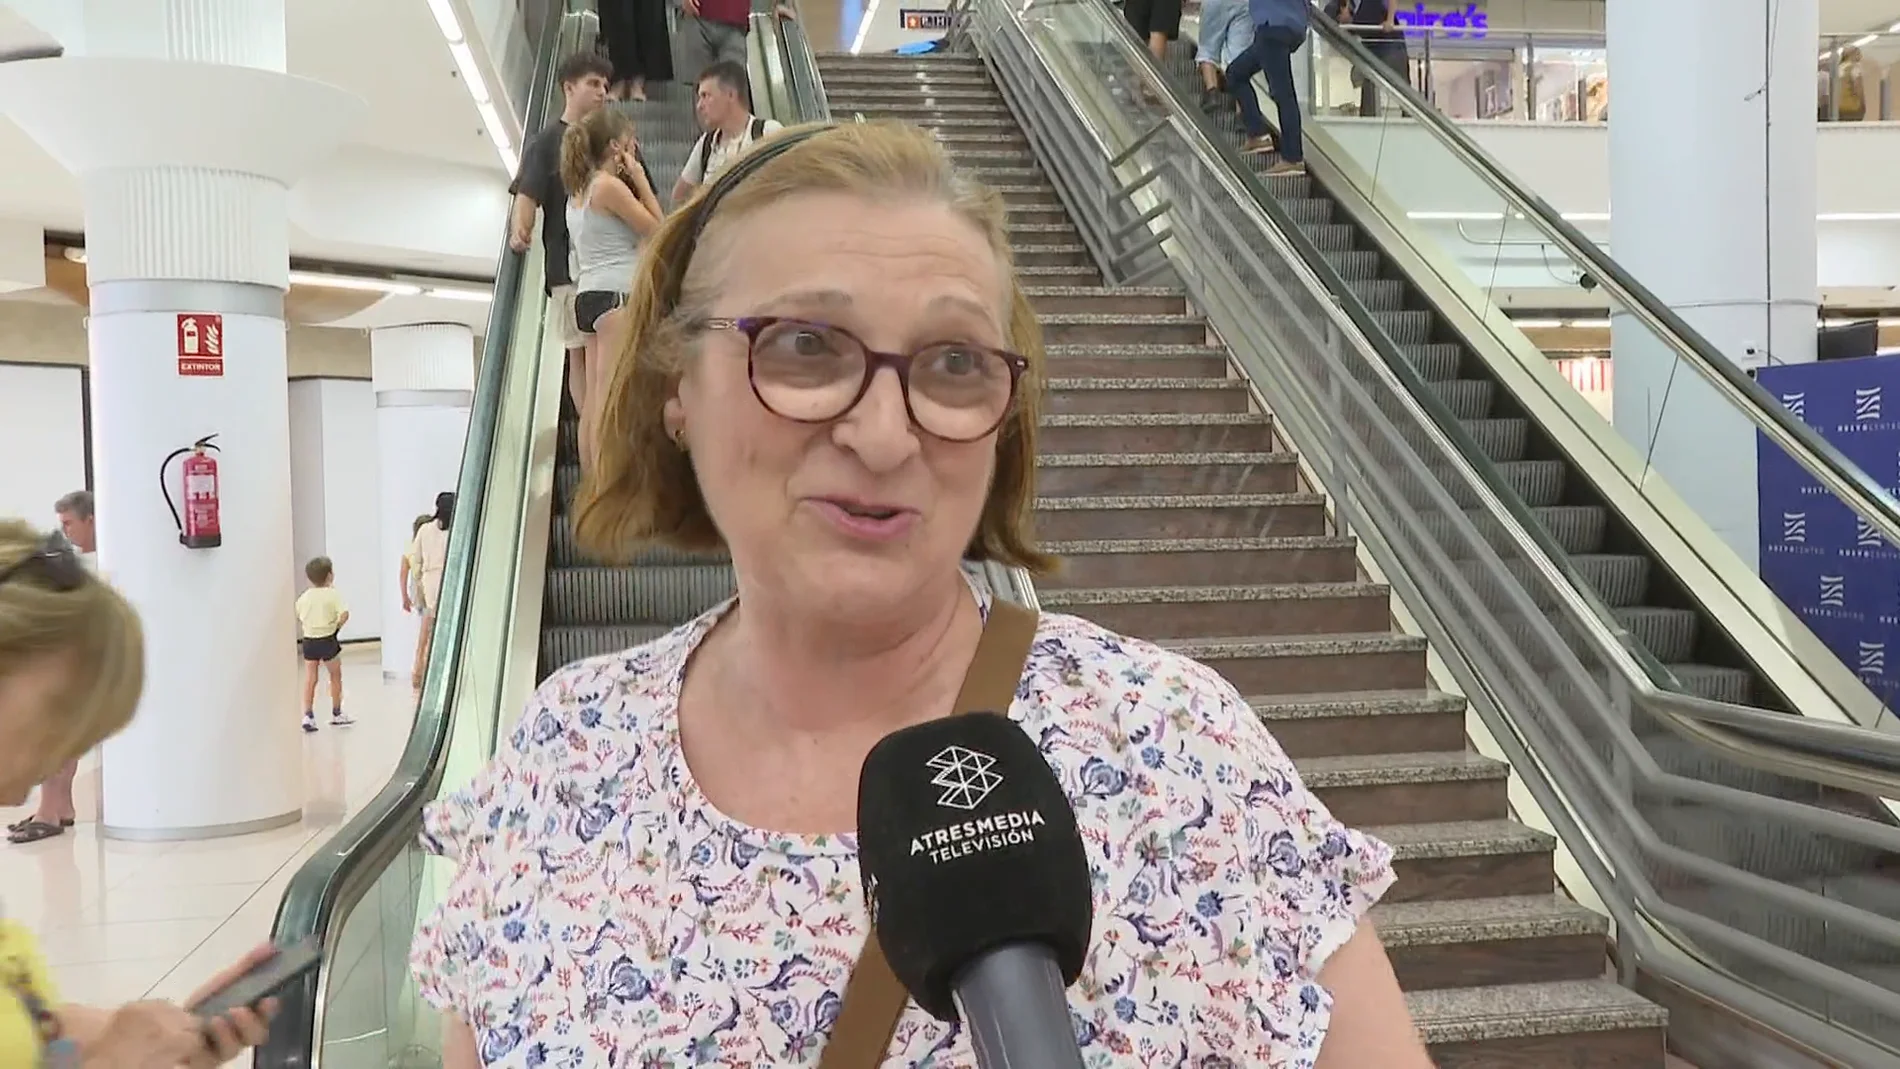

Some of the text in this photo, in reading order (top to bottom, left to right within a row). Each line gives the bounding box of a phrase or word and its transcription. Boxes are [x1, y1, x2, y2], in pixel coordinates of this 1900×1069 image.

[181, 362, 221, 371] EXTINTOR
[909, 810, 1046, 856] ATRESMEDIA
[929, 827, 1035, 865] TELEVISIÓN
